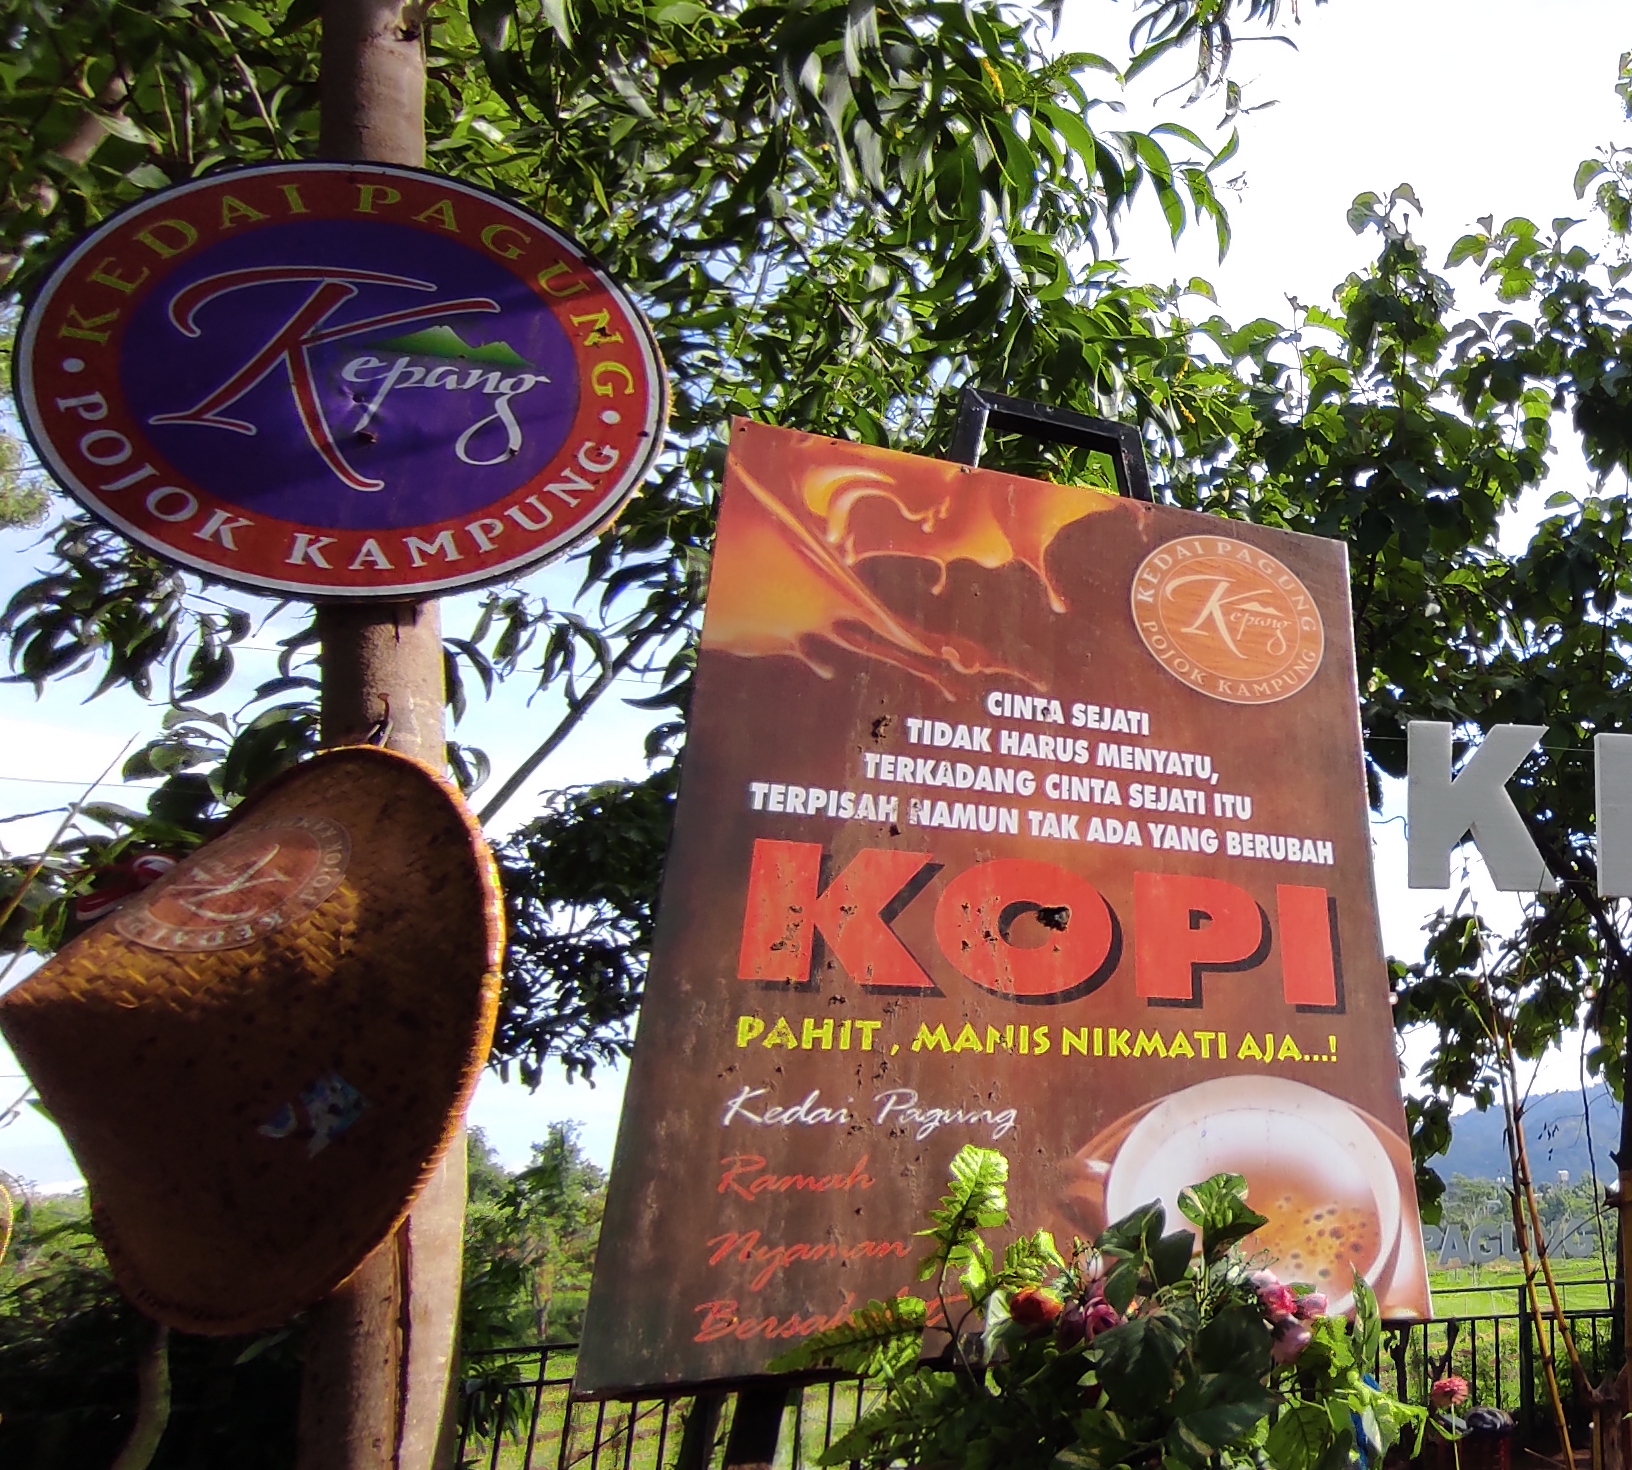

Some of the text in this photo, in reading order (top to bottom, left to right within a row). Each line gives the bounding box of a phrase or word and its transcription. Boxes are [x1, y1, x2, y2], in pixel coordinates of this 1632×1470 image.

[57, 182, 634, 397] KEDAI PAGUNG
[149, 265, 551, 492] Kepang
[56, 392, 621, 570] POJOK KAMPUNG
[1137, 541, 1317, 632] KEDAI PAGUNG
[1165, 574, 1293, 659] Kepang
[1142, 621, 1316, 697] POJOK KAMPUNG
[906, 717, 1220, 785] TIDAK HARUS MENYATU,
[986, 691, 1150, 736] CINTA SEJATI
[749, 782, 1334, 866] TERPISAH NAMUN TAK ADA YANG BERUBAH
[863, 752, 1253, 820] TERKADANG CINTA SEJATI ITU
[737, 837, 1338, 1007] KOPI
[911, 1022, 1052, 1056] MANIS
[1061, 1026, 1228, 1060] NIKMATI
[1236, 1034, 1339, 1064] AJA...!
[721, 1084, 1018, 1141] Kedai Pagung
[716, 1153, 877, 1201] Ramah
[706, 1229, 912, 1292] Nyaman
